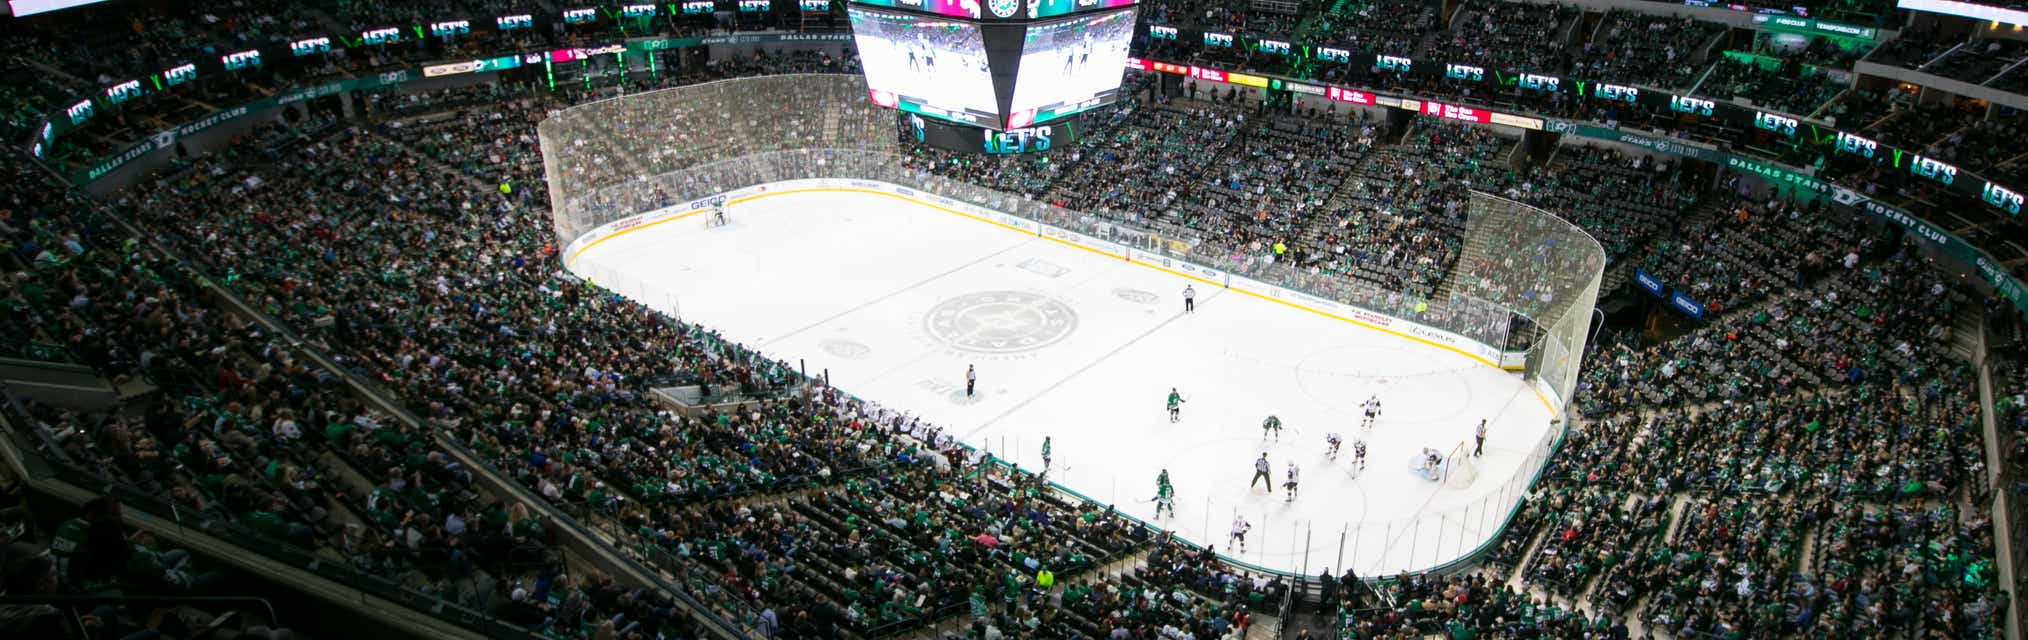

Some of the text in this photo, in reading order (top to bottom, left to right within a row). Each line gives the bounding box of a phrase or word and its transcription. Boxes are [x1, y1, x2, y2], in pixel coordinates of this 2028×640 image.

[623, 4, 656, 17] LET'S
[682, 1, 715, 14] LET'S
[739, 0, 770, 12] LET'S
[496, 14, 533, 31] LET'S
[563, 8, 597, 24] LET'S
[362, 27, 400, 45] LET'S
[430, 20, 470, 37] LET'S
[1150, 25, 1178, 41] LET'S
[290, 37, 331, 56] LET'S
[1204, 32, 1233, 48] LET'S
[1259, 39, 1290, 56] LET'S
[221, 49, 261, 71] LET'S
[1316, 46, 1350, 64] LET'S
[1376, 54, 1412, 73] LET'S
[164, 63, 197, 87] LET'S
[1446, 63, 1485, 82] LET'S
[106, 79, 141, 105] LET'S
[1519, 73, 1559, 92] LET'S
[1595, 83, 1638, 104] LET'S
[1671, 95, 1716, 117] LET'S
[1755, 111, 1798, 137] LET'S
[89, 107, 248, 180] DALLAS STARS HOCKEY CLUB
[984, 126, 1051, 155] LET'S
[1836, 131, 1877, 159] LET'S
[1910, 154, 1958, 185] LET'S
[691, 195, 726, 210] GEICO
[1729, 157, 1948, 245] DALLAS STARS HOCKEY CLUB
[1982, 181, 2024, 216] LET'S
[1675, 296, 1699, 314] GEICO
